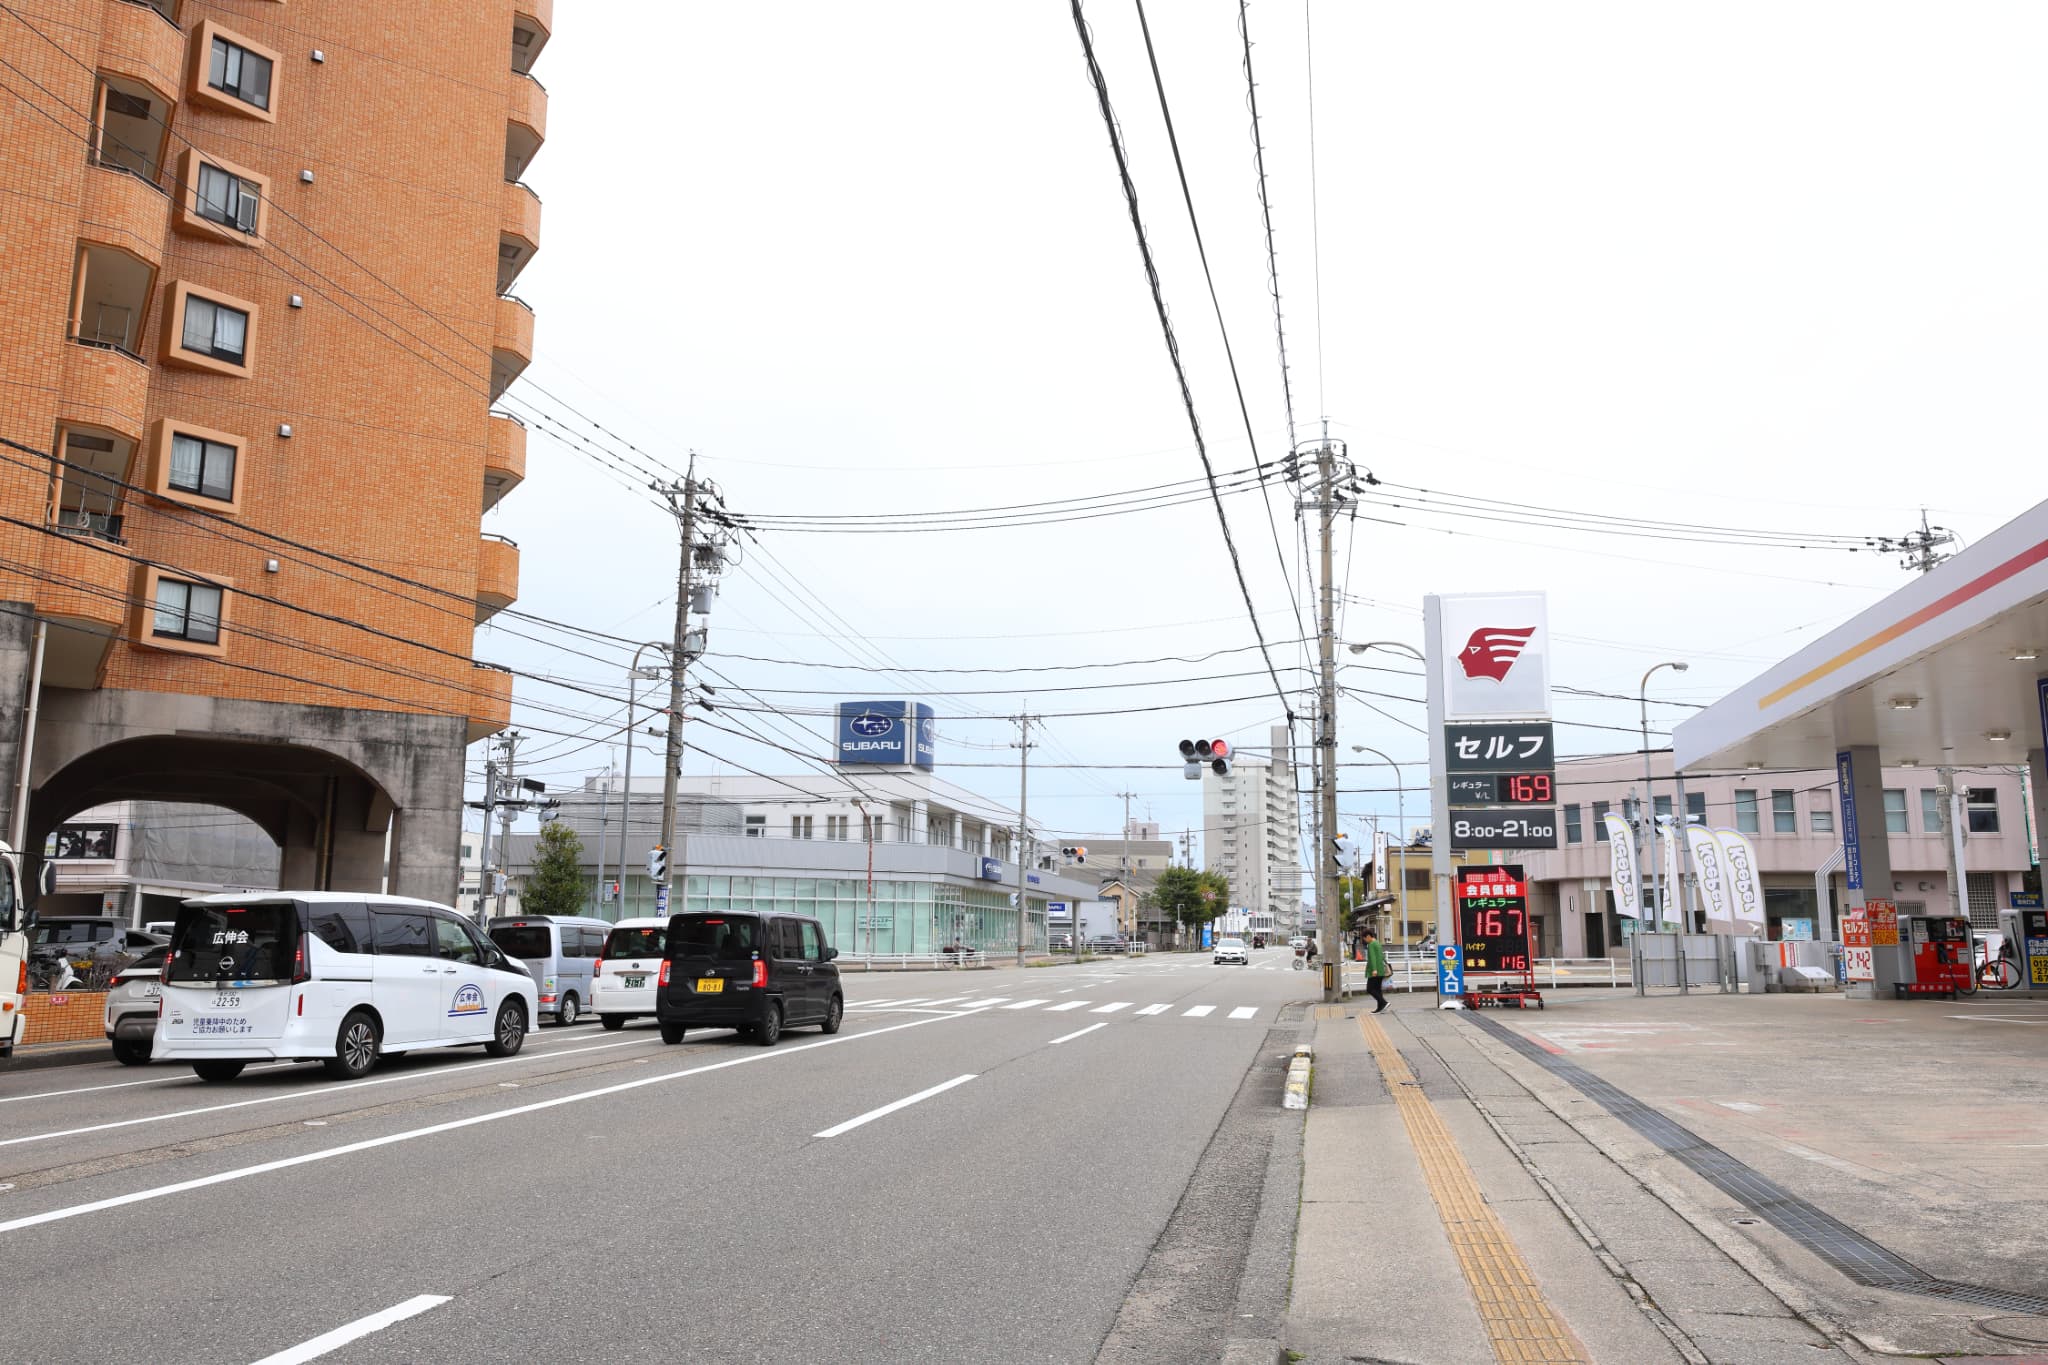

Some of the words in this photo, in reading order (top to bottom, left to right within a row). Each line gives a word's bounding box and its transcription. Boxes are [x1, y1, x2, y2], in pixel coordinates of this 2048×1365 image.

[842, 741, 902, 751] SUBARU
[1455, 735, 1544, 760] セルフ
[1452, 780, 1491, 790] レギュラー
[1510, 775, 1551, 802] 169
[1454, 820, 1553, 838] 8:00-21:00
[1467, 897, 1518, 909] レギュラー
[1476, 909, 1523, 937] 167
[1843, 921, 1864, 934] セルフ
[212, 930, 249, 945] 広伸会
[1465, 943, 1486, 952] ハイオク
[1444, 970, 1459, 993] 入口
[216, 997, 240, 1007] 22-59
